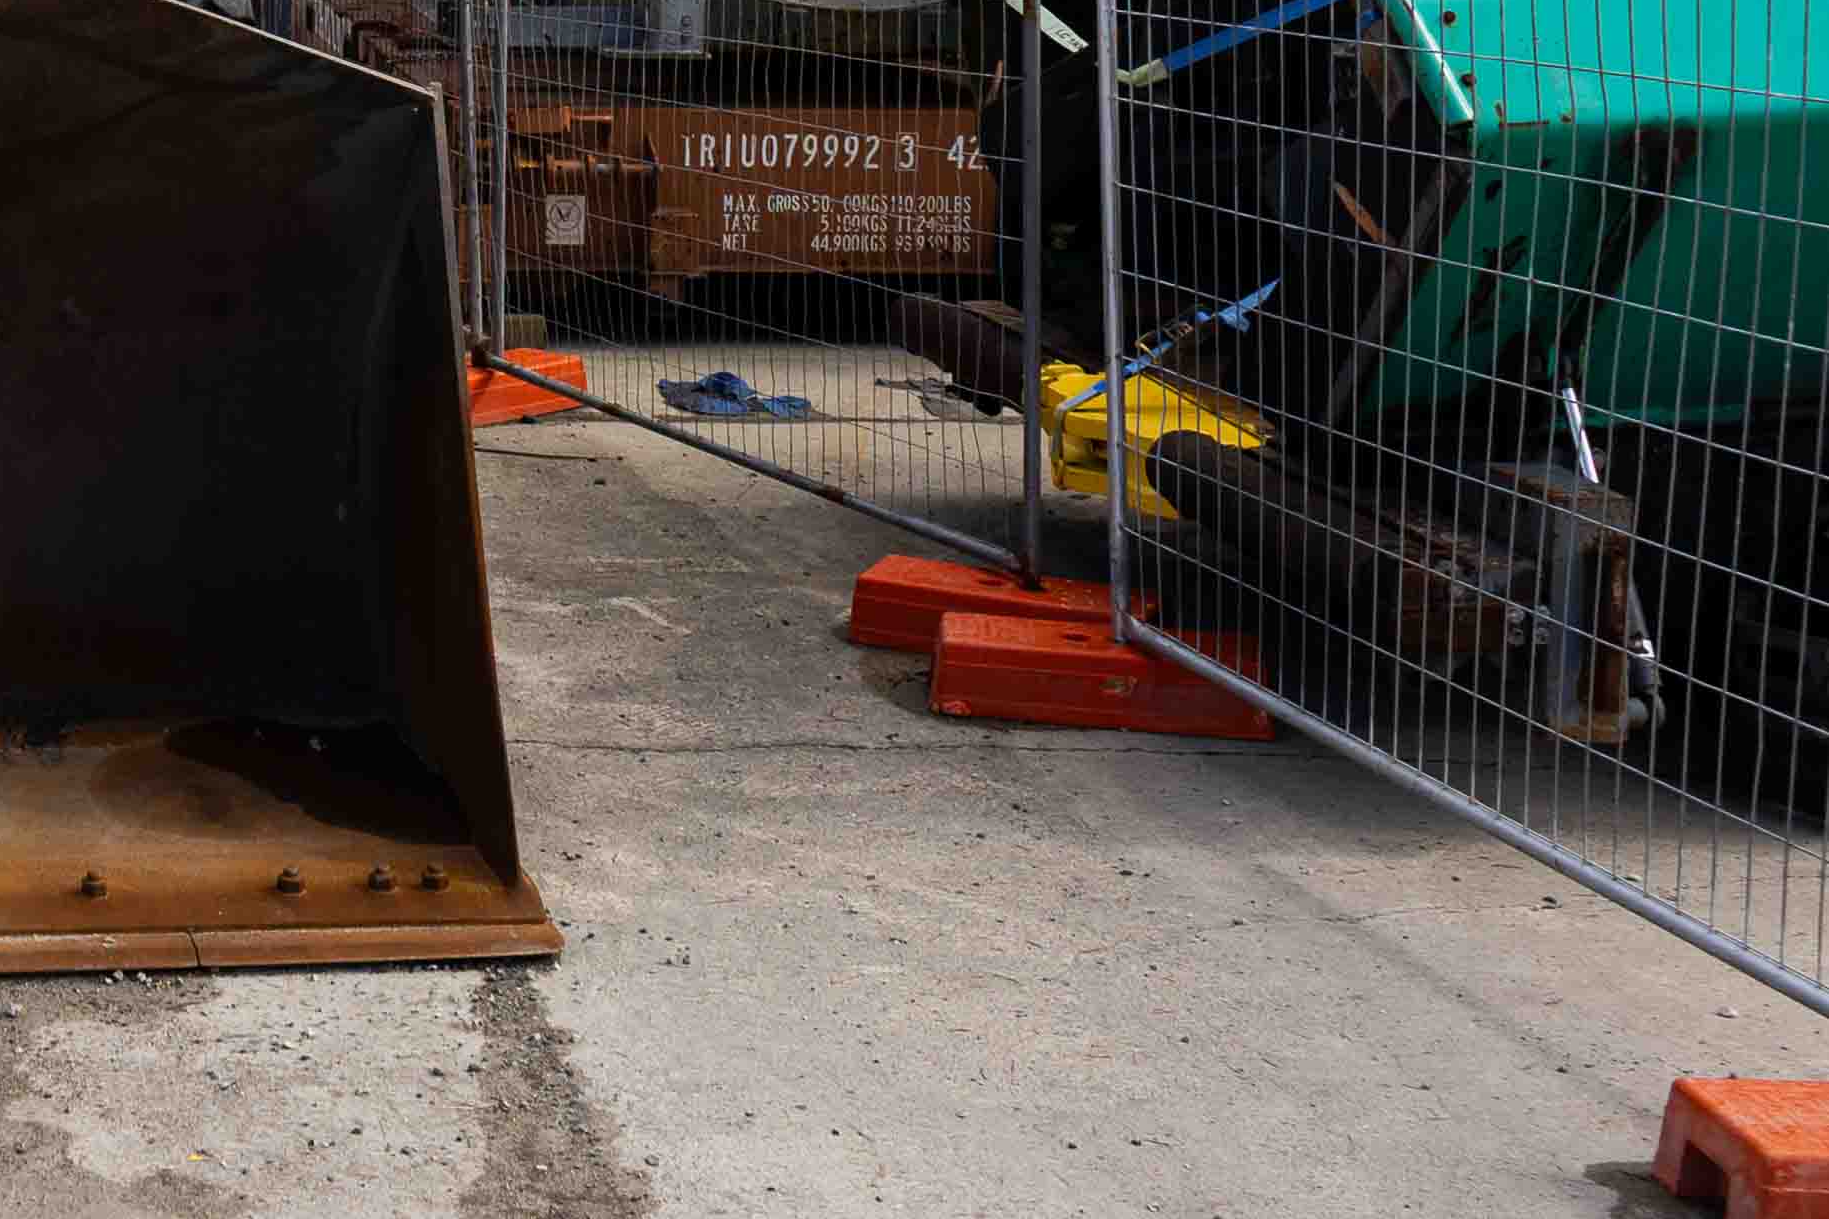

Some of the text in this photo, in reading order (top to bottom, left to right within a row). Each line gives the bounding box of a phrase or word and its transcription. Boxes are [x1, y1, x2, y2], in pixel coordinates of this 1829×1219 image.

[897, 134, 916, 169] 3
[767, 194, 811, 213] GROSS
[722, 233, 748, 253] NET
